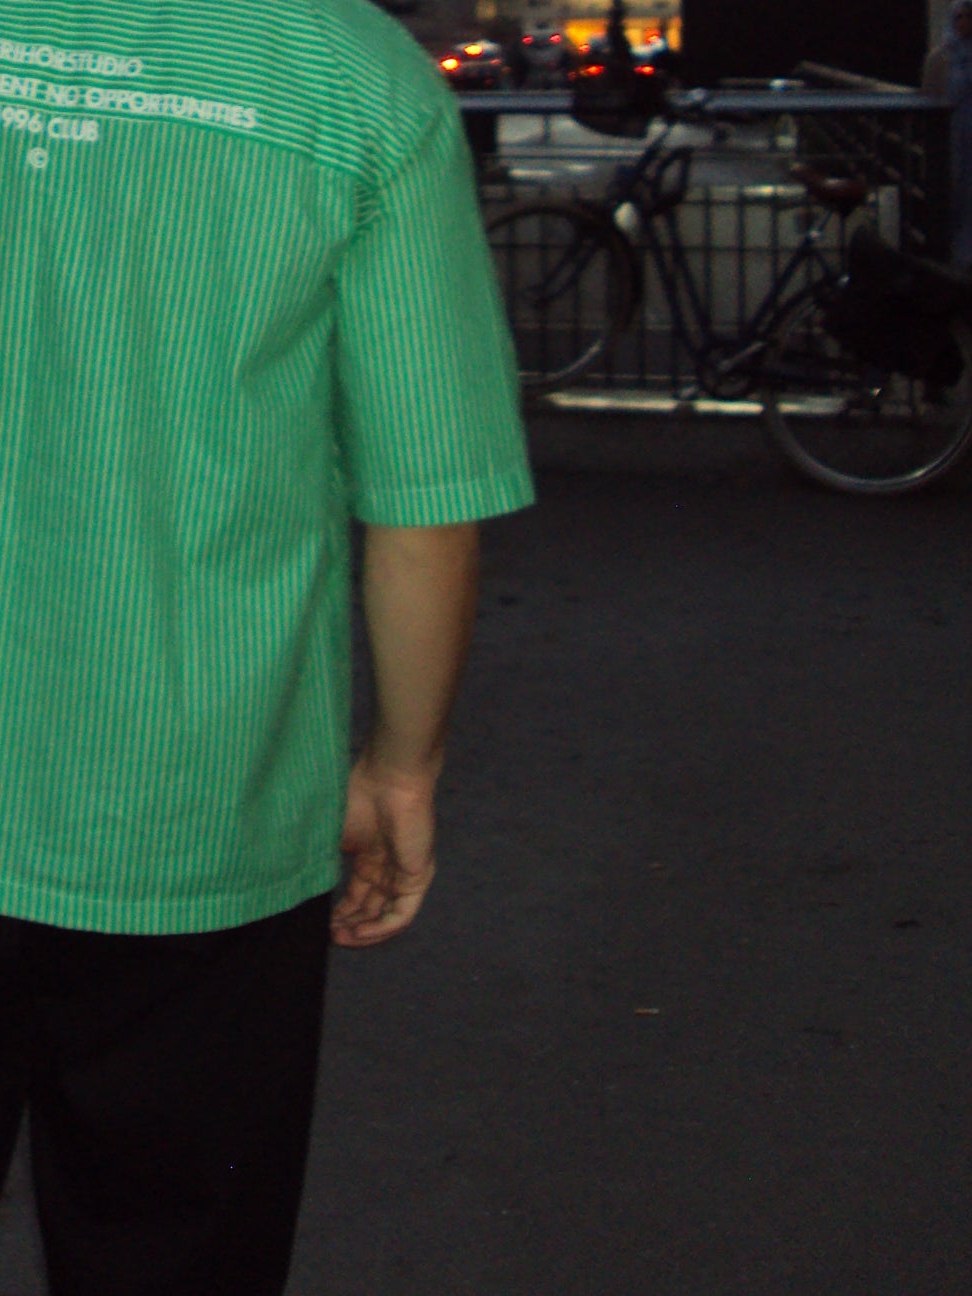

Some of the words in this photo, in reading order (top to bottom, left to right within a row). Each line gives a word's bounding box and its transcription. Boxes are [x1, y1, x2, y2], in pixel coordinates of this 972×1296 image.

[45, 82, 79, 106] NO
[85, 87, 257, 128] OPPORTUNITIES
[47, 116, 99, 143] CLUB
